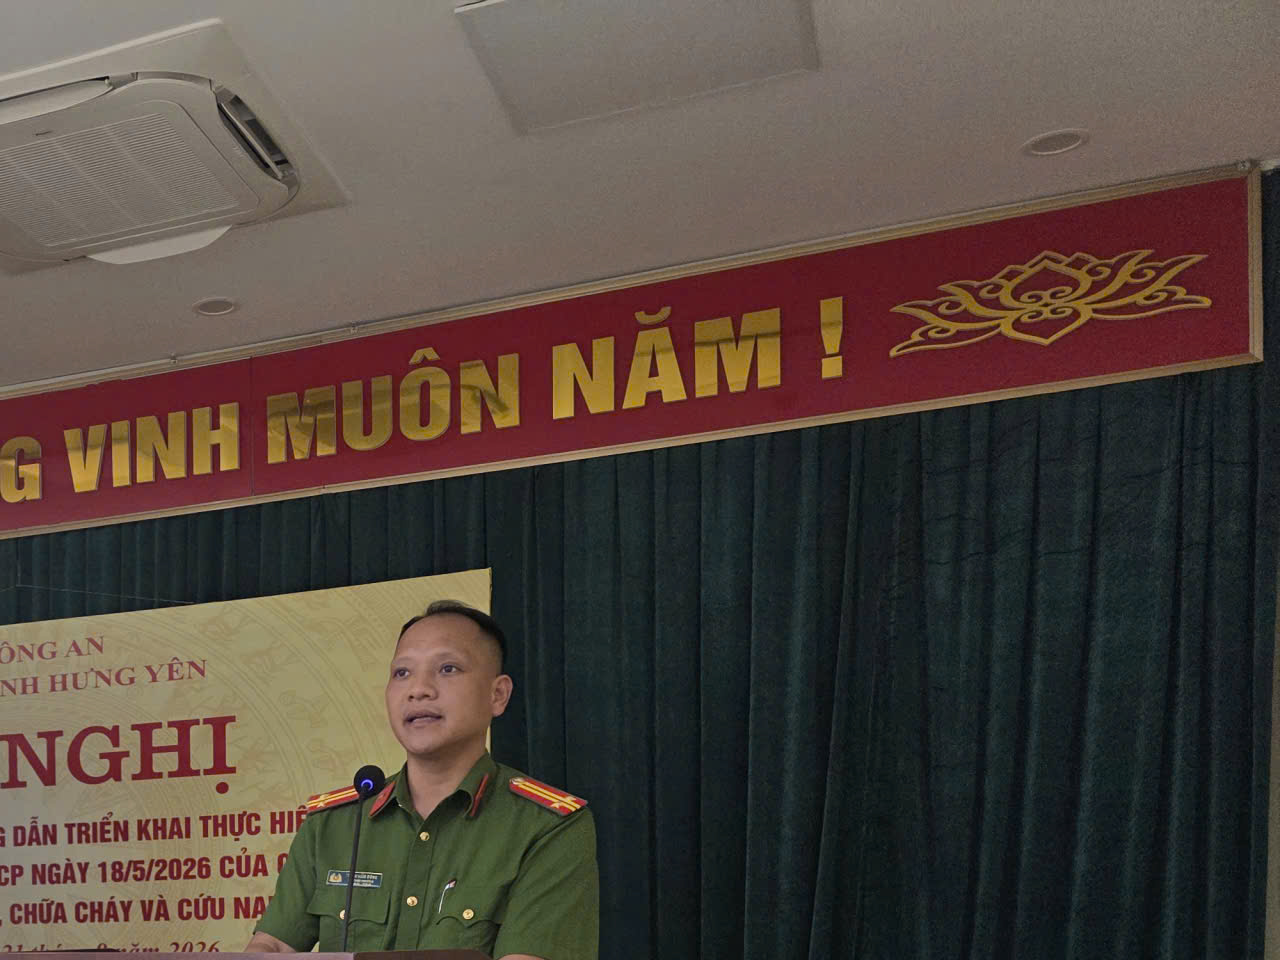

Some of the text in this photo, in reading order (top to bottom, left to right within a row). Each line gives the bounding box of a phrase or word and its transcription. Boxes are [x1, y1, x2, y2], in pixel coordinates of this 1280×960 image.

[63, 401, 240, 494] VINH
[266, 347, 520, 464] MUÔN
[551, 306, 782, 420] NĂM
[820, 296, 844, 379] !
[64, 636, 104, 657] AN
[48, 666, 136, 692] HƯNG
[144, 656, 207, 683] YÊN
[0, 715, 236, 794] NGHỊ
[13, 816, 57, 847] DẪN
[64, 811, 128, 844] TRIỂN
[137, 817, 190, 841] KHAI
[199, 810, 261, 841] THỰC
[31, 858, 89, 885] NGÀY
[98, 857, 211, 883] 18/5/2026
[220, 847, 269, 878] CỦA
[10, 899, 67, 925] CHỮA
[74, 896, 133, 923] CHÁY
[140, 894, 170, 922] VÀ
[178, 893, 225, 921] CỨU
